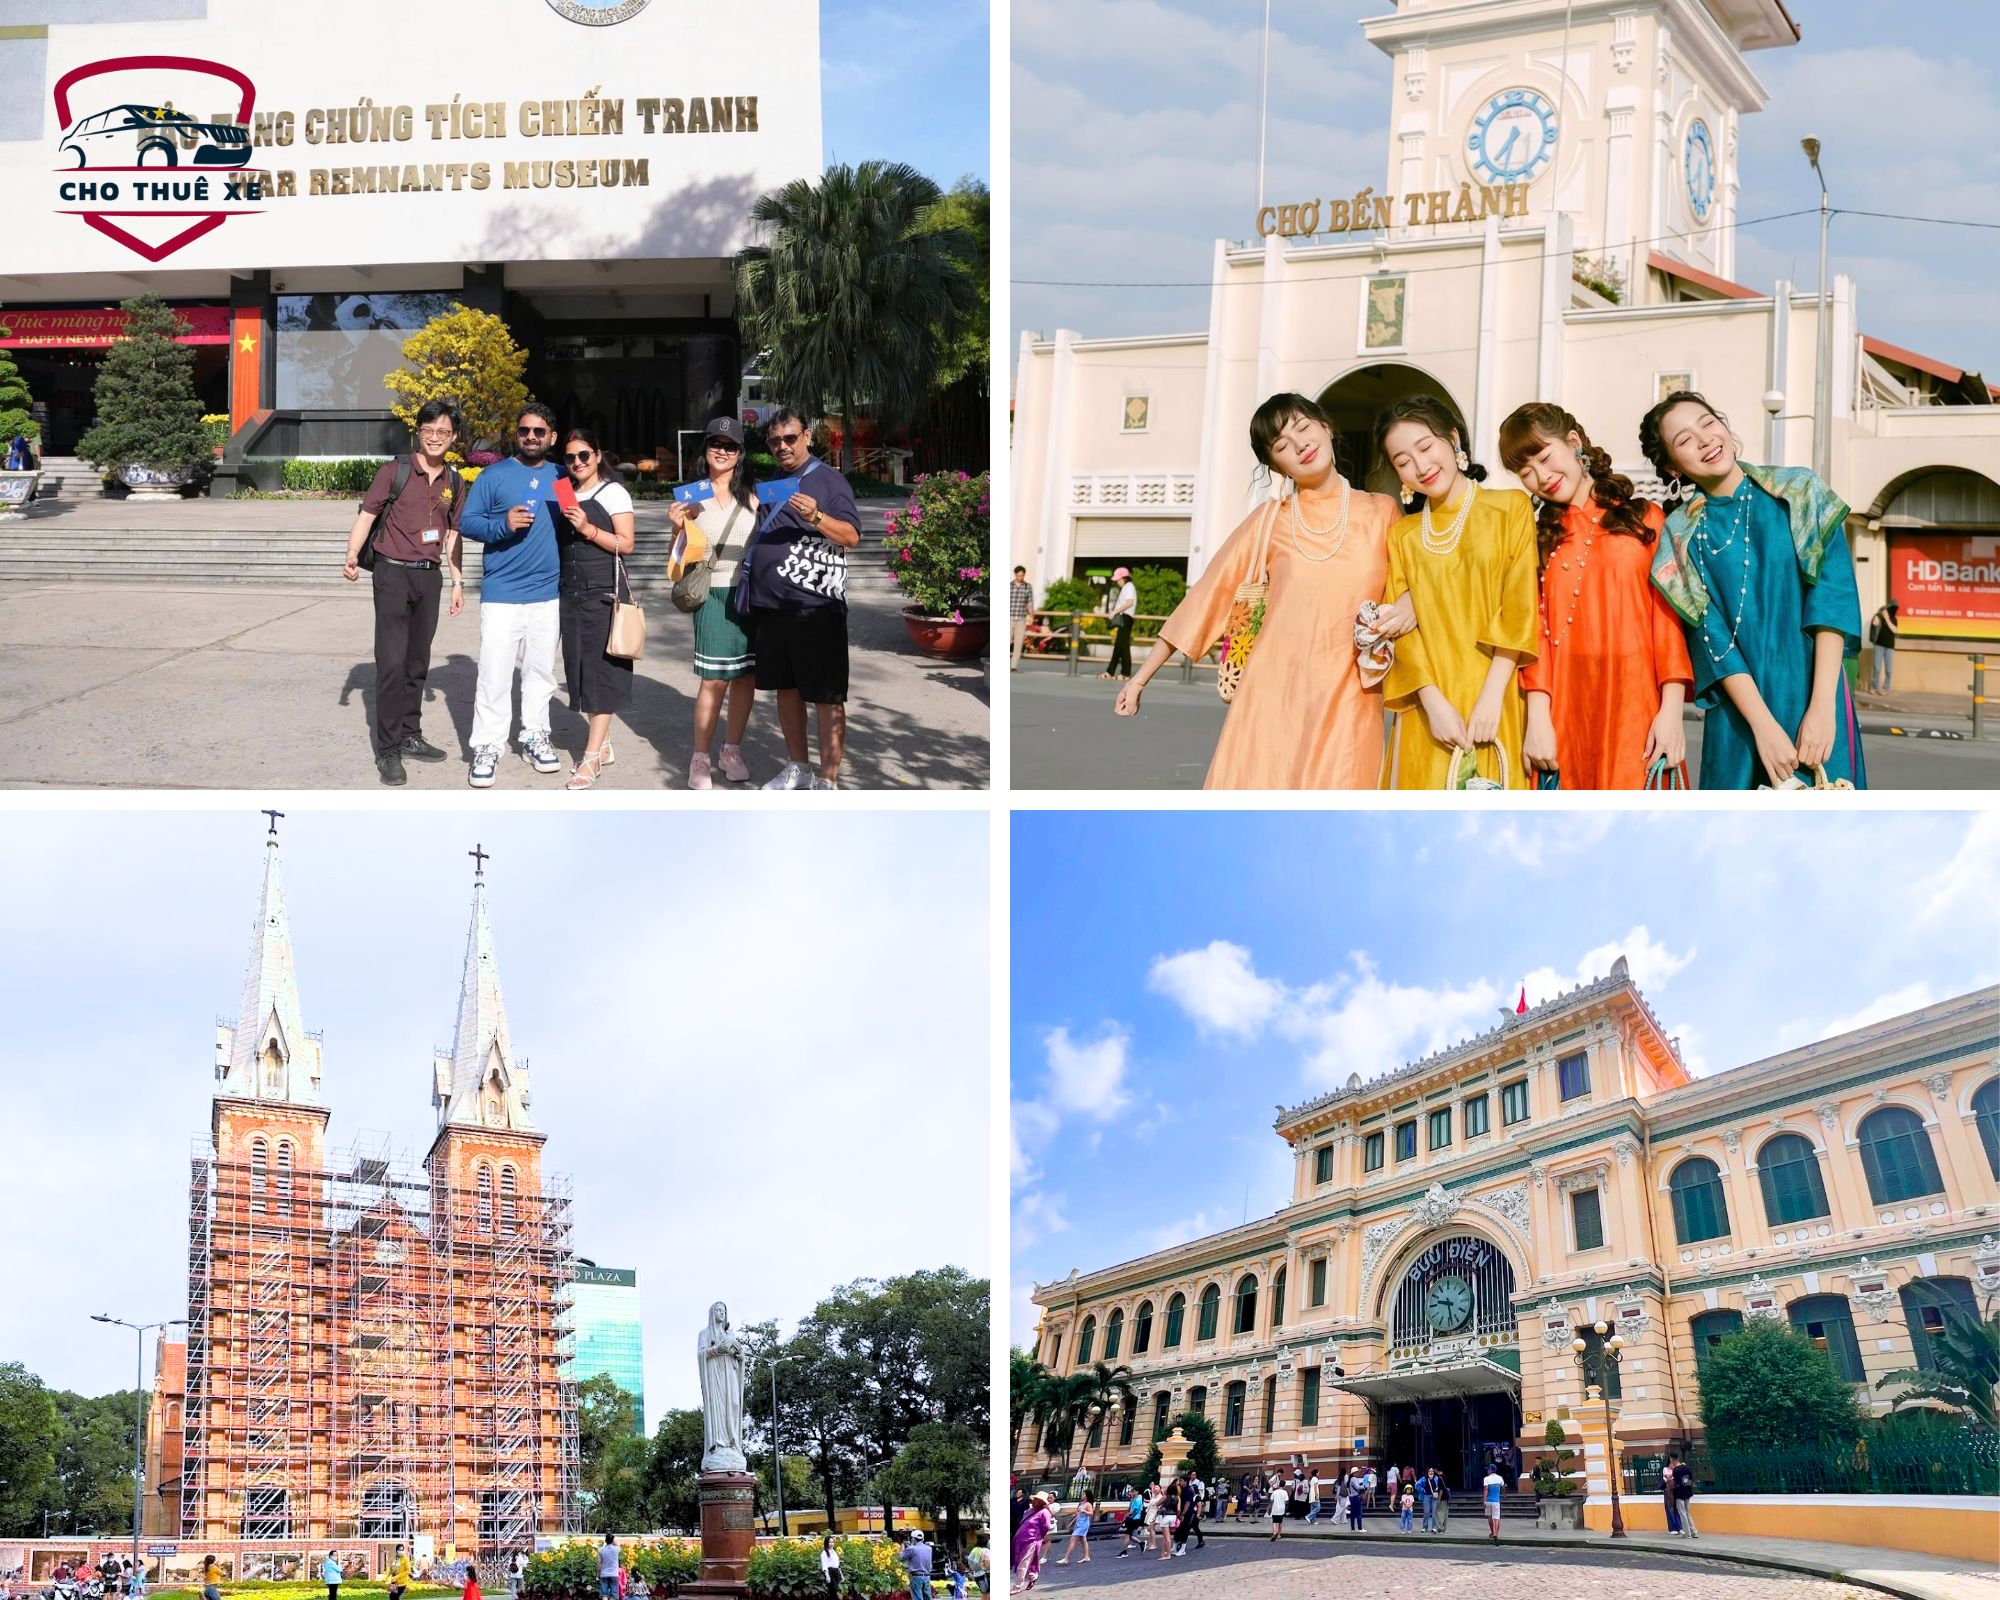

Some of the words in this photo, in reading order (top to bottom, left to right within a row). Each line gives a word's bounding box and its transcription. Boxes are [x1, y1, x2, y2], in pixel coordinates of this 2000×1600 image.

[571, 12, 614, 25] REMNANTS
[305, 97, 413, 145] CHỨNG
[425, 93, 507, 140] TÍCH
[518, 85, 624, 137] CHIẾN
[636, 96, 759, 134] TRANH
[228, 169, 298, 199] WAR
[309, 162, 491, 197] REMNANTS
[503, 158, 650, 190] MUSEUM
[1256, 198, 1322, 238] CHỢ
[1329, 186, 1394, 233] BẾN
[1404, 181, 1530, 226] THÀNH
[1, 313, 49, 330] Chúc
[19, 334, 63, 345] HAPPY
[65, 334, 98, 344] NEW
[719, 418, 731, 432] C
[1907, 560, 2000, 582] HDBank
[1408, 1247, 1442, 1282] BƯU
[584, 1270, 622, 1282] PLAZA
